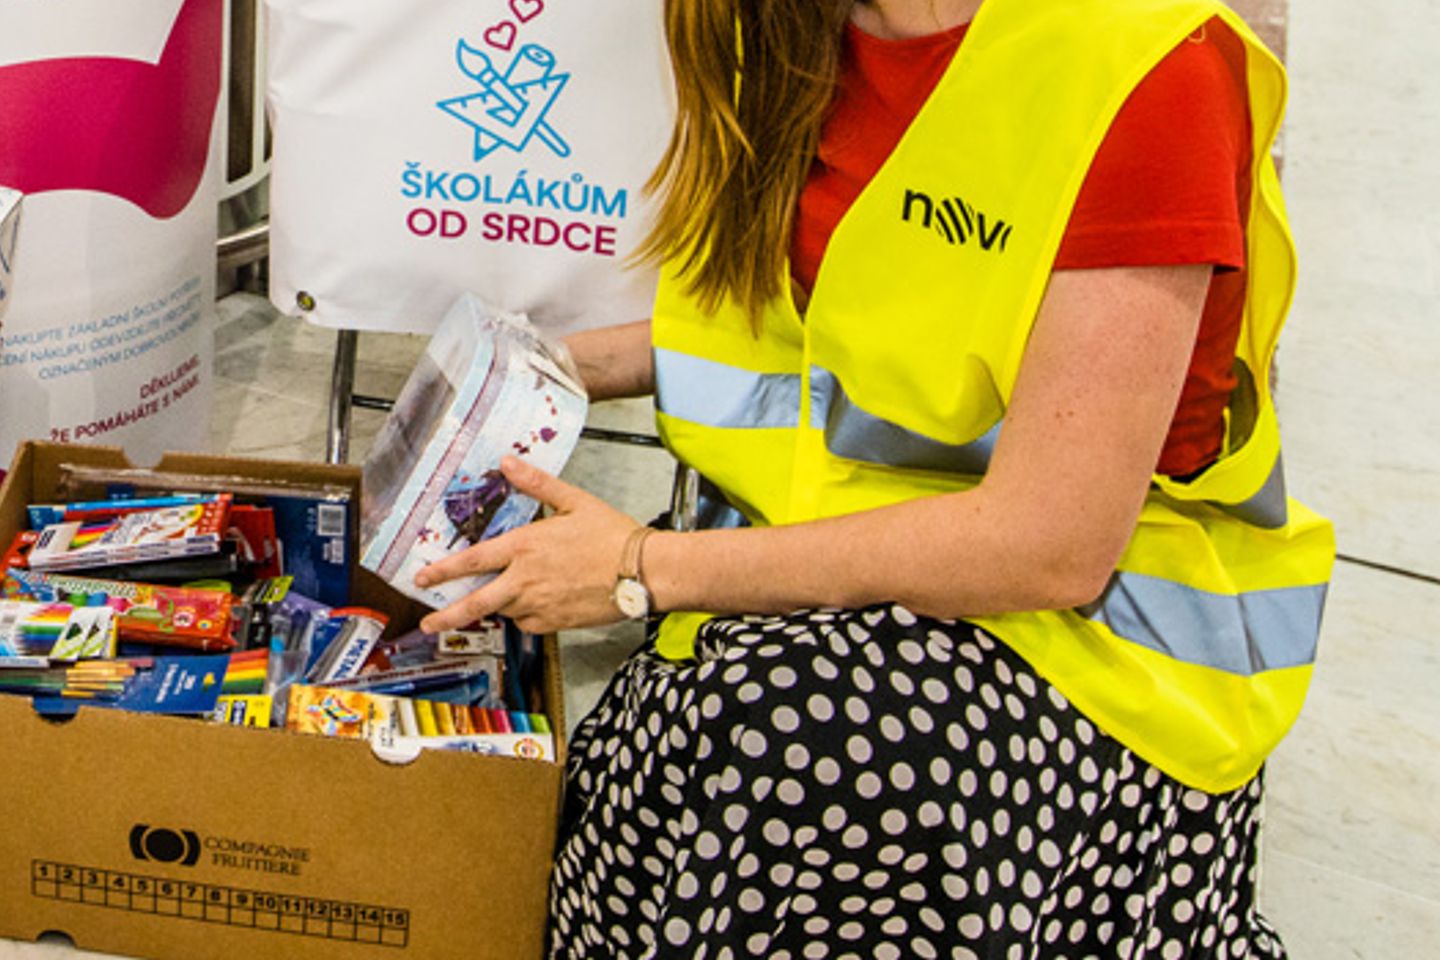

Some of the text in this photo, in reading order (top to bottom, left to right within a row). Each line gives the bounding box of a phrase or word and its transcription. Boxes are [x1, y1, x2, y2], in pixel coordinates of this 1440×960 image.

[401, 161, 628, 218] ŠKOLÁKŮM
[406, 207, 617, 256] OD SRDCE
[204, 836, 311, 861] COMPAGNIE
[212, 852, 302, 876] FRUITIERE
[40, 865, 405, 926] 1 2 3 4 5 6 7 8 9 10 11 12 13 14 15
